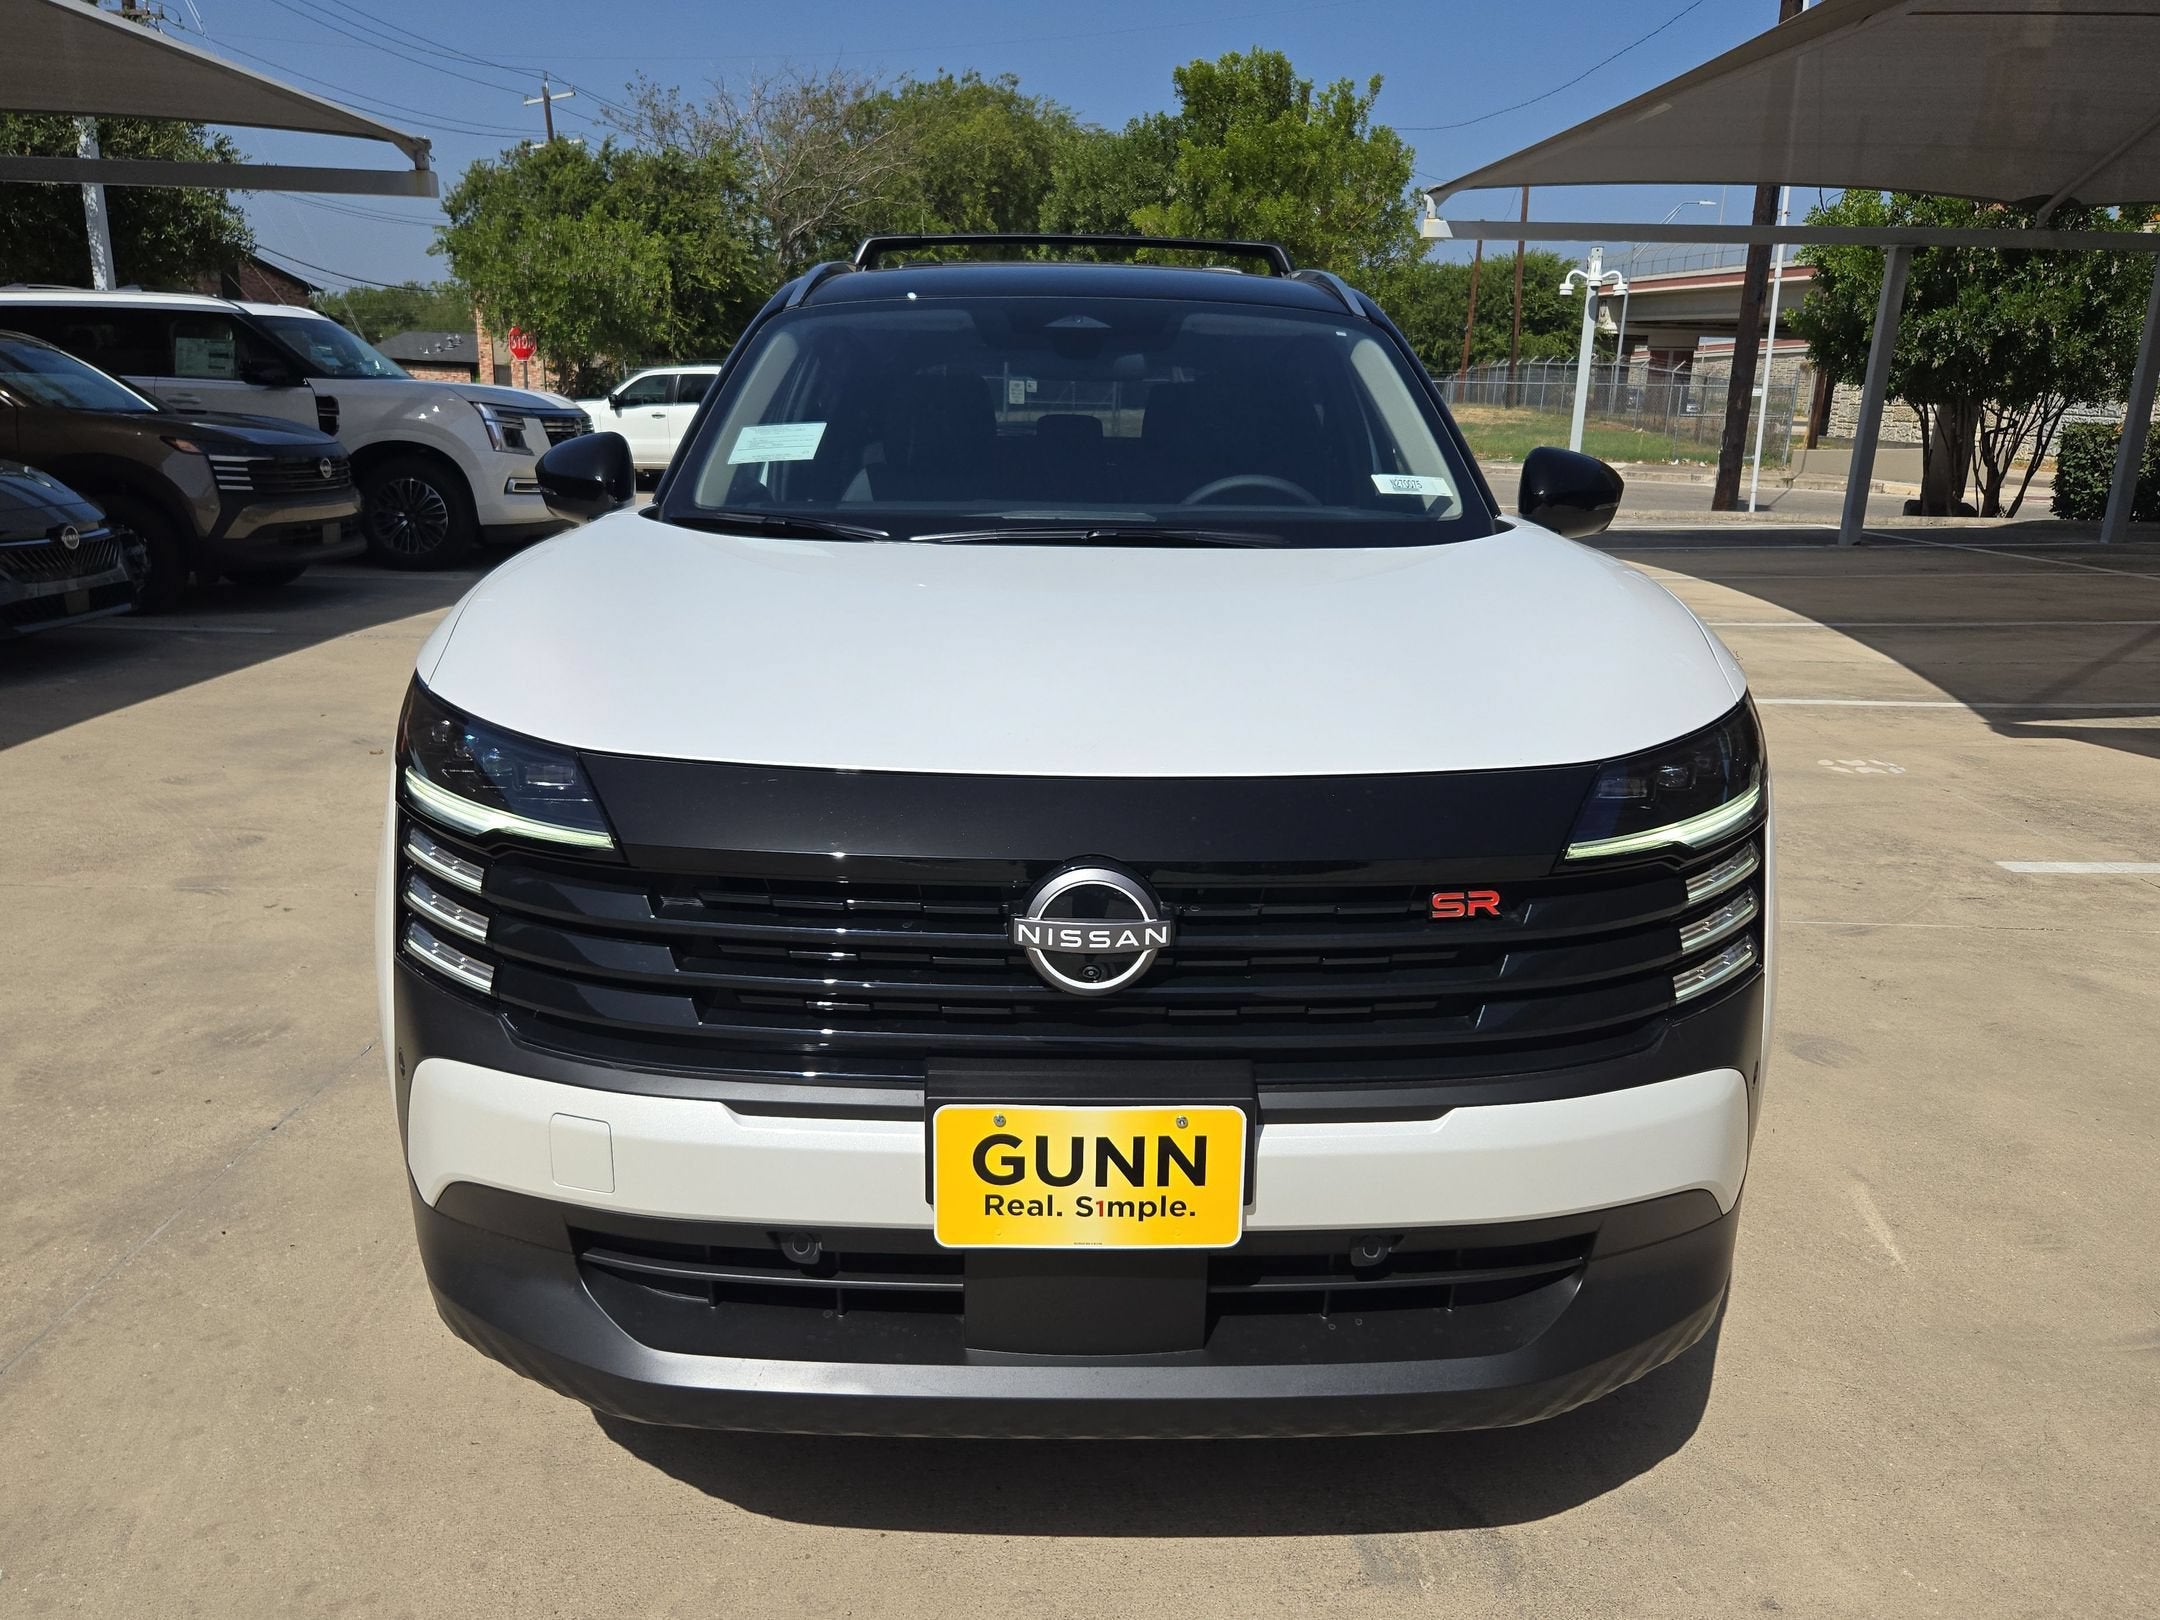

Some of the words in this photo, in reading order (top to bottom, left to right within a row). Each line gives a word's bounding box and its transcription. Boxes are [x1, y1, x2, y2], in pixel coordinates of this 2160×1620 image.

[1432, 890, 1500, 918] SR
[1018, 924, 1167, 948] NISSAN
[972, 1133, 1207, 1188] GUNN
[984, 1194, 1063, 1217] Real.
